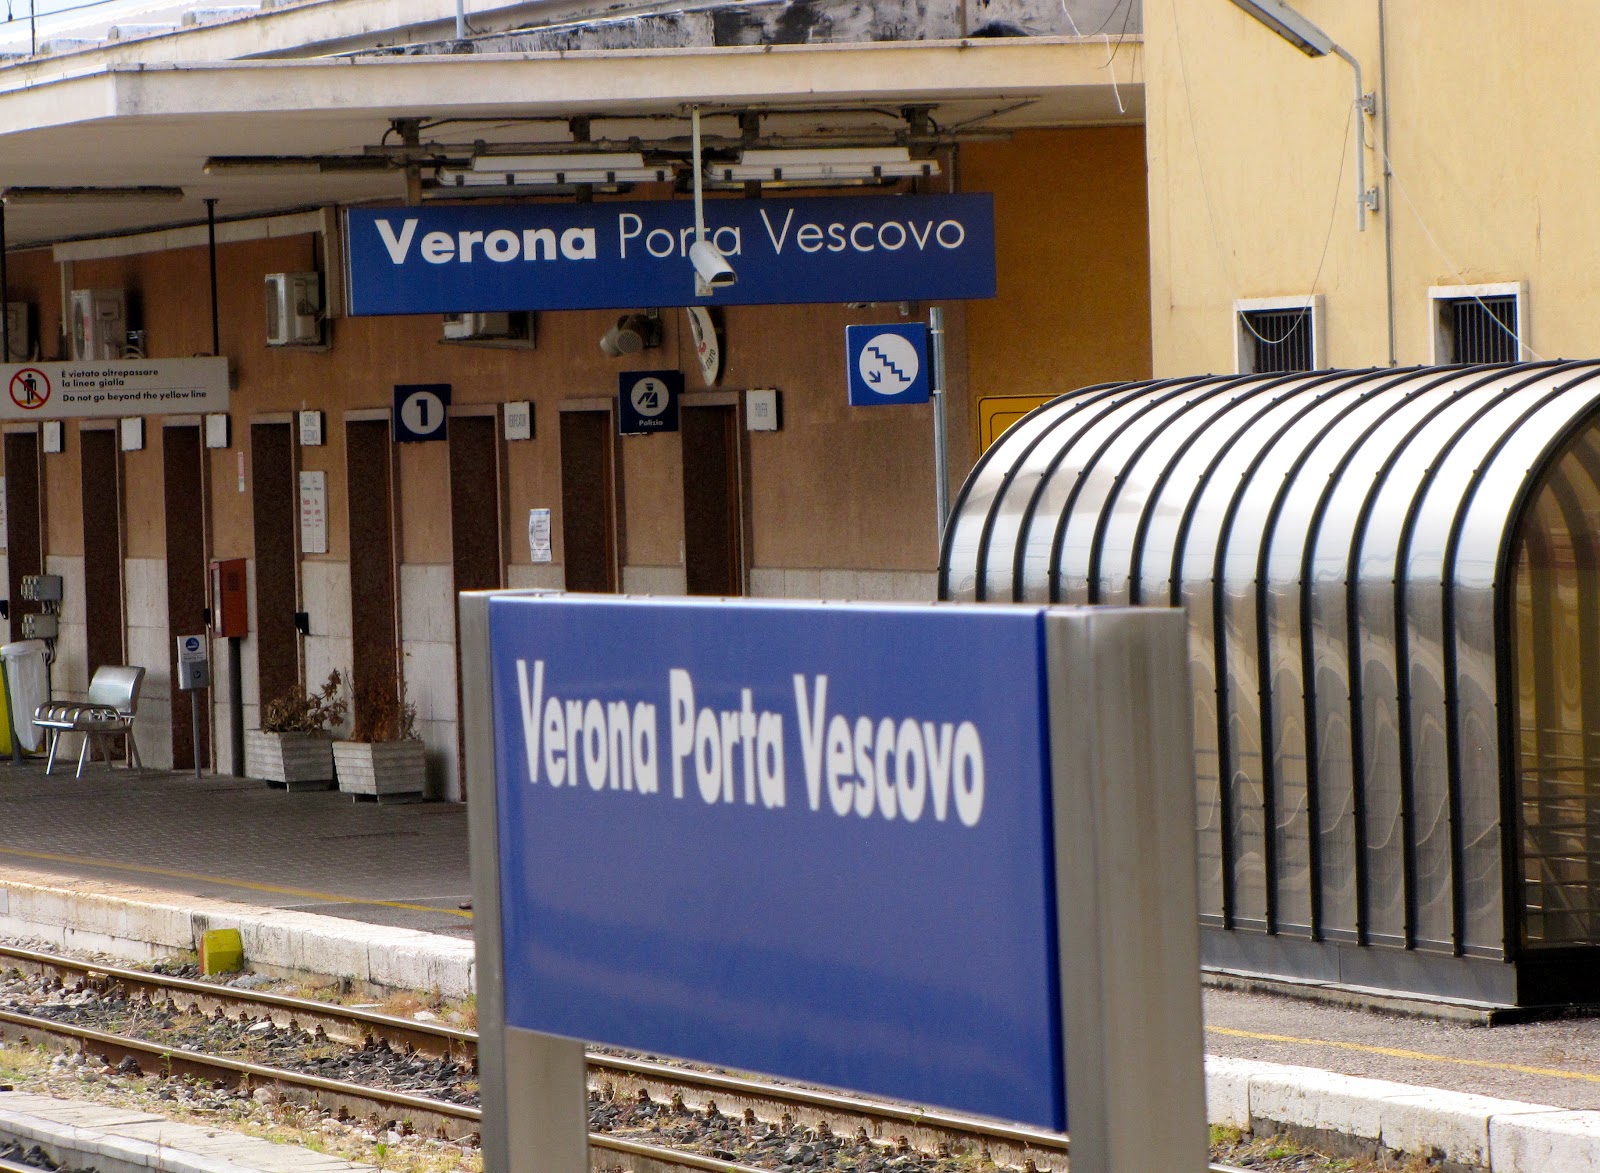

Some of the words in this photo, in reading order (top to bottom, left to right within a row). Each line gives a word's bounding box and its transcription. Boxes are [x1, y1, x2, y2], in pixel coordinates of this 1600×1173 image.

[374, 218, 597, 265] Verona
[760, 207, 966, 256] Vescovo
[68, 370, 100, 378] vietato
[102, 368, 158, 378] oltrepassare
[62, 380, 70, 388] la
[98, 378, 124, 388] gialla
[108, 392, 140, 402] beyond
[143, 392, 158, 400] the
[160, 390, 189, 401] yellow
[190, 390, 206, 398] line
[416, 398, 428, 427] 1
[638, 419, 664, 427] Polizia
[516, 659, 659, 794] Verona
[669, 667, 786, 809] Porta
[792, 673, 985, 828] Vescovo
